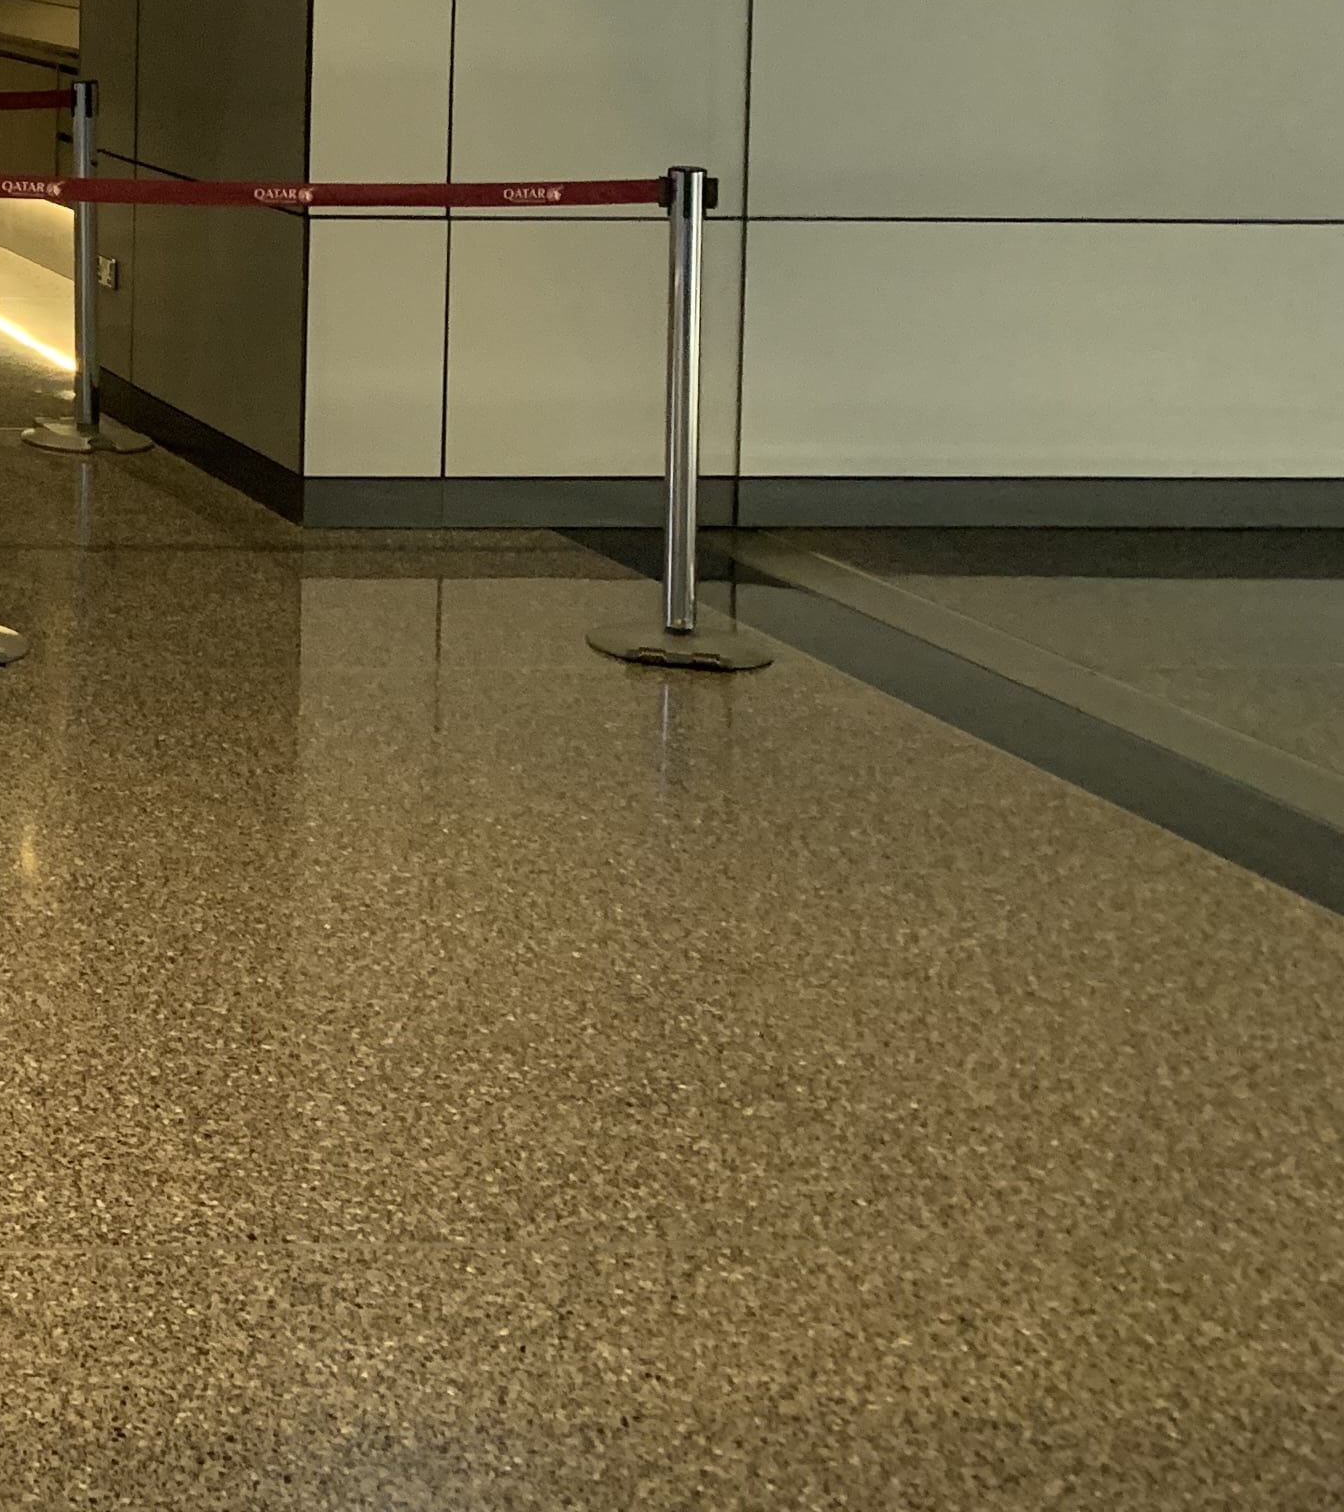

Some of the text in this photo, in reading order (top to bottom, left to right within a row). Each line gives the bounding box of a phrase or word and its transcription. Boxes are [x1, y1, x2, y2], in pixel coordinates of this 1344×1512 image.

[1, 180, 45, 192] QATAR
[254, 188, 297, 200] QATAR
[503, 188, 546, 201] QATAR
